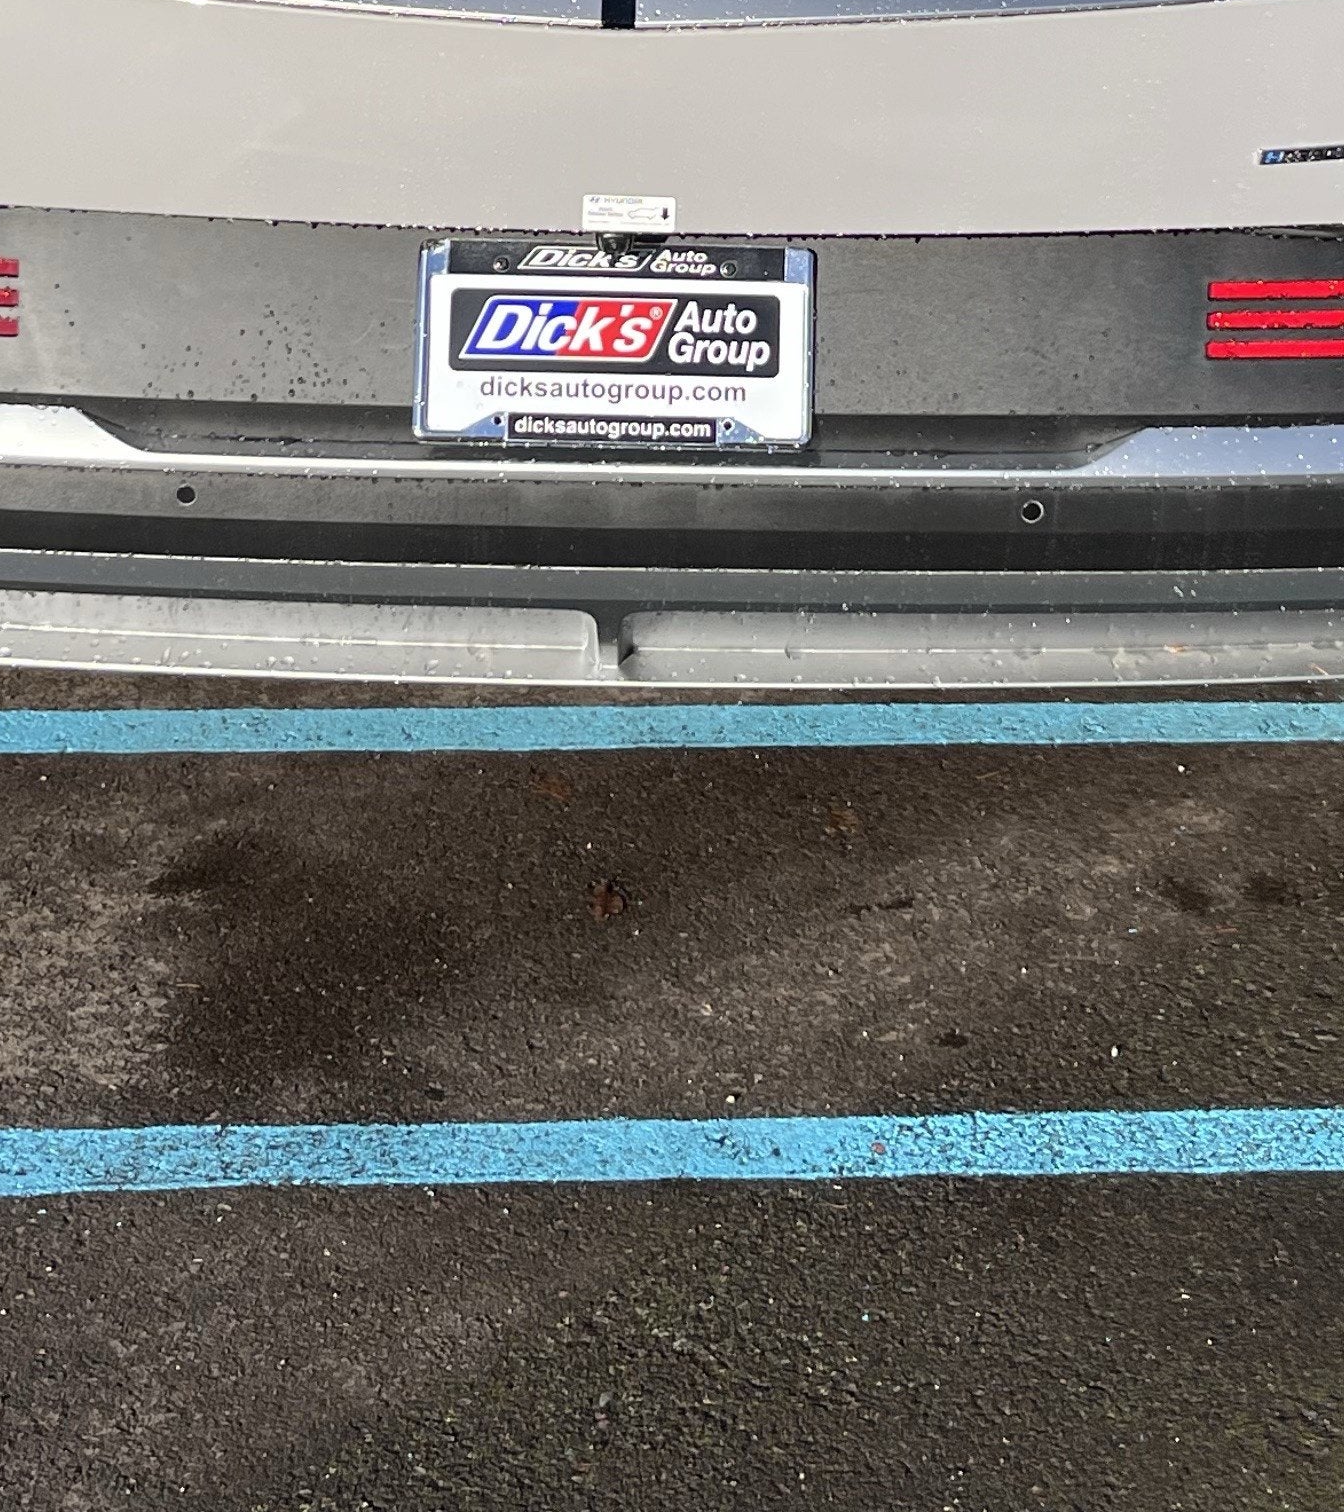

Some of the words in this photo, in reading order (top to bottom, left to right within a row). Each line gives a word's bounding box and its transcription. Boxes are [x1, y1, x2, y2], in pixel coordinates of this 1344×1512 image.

[649, 258, 718, 276] Group
[659, 248, 709, 264] Auto
[673, 300, 758, 336] Auto
[667, 331, 771, 372] Group
[480, 376, 747, 405] dicksautogroup.com
[513, 415, 712, 440] dicksautogroup.com
